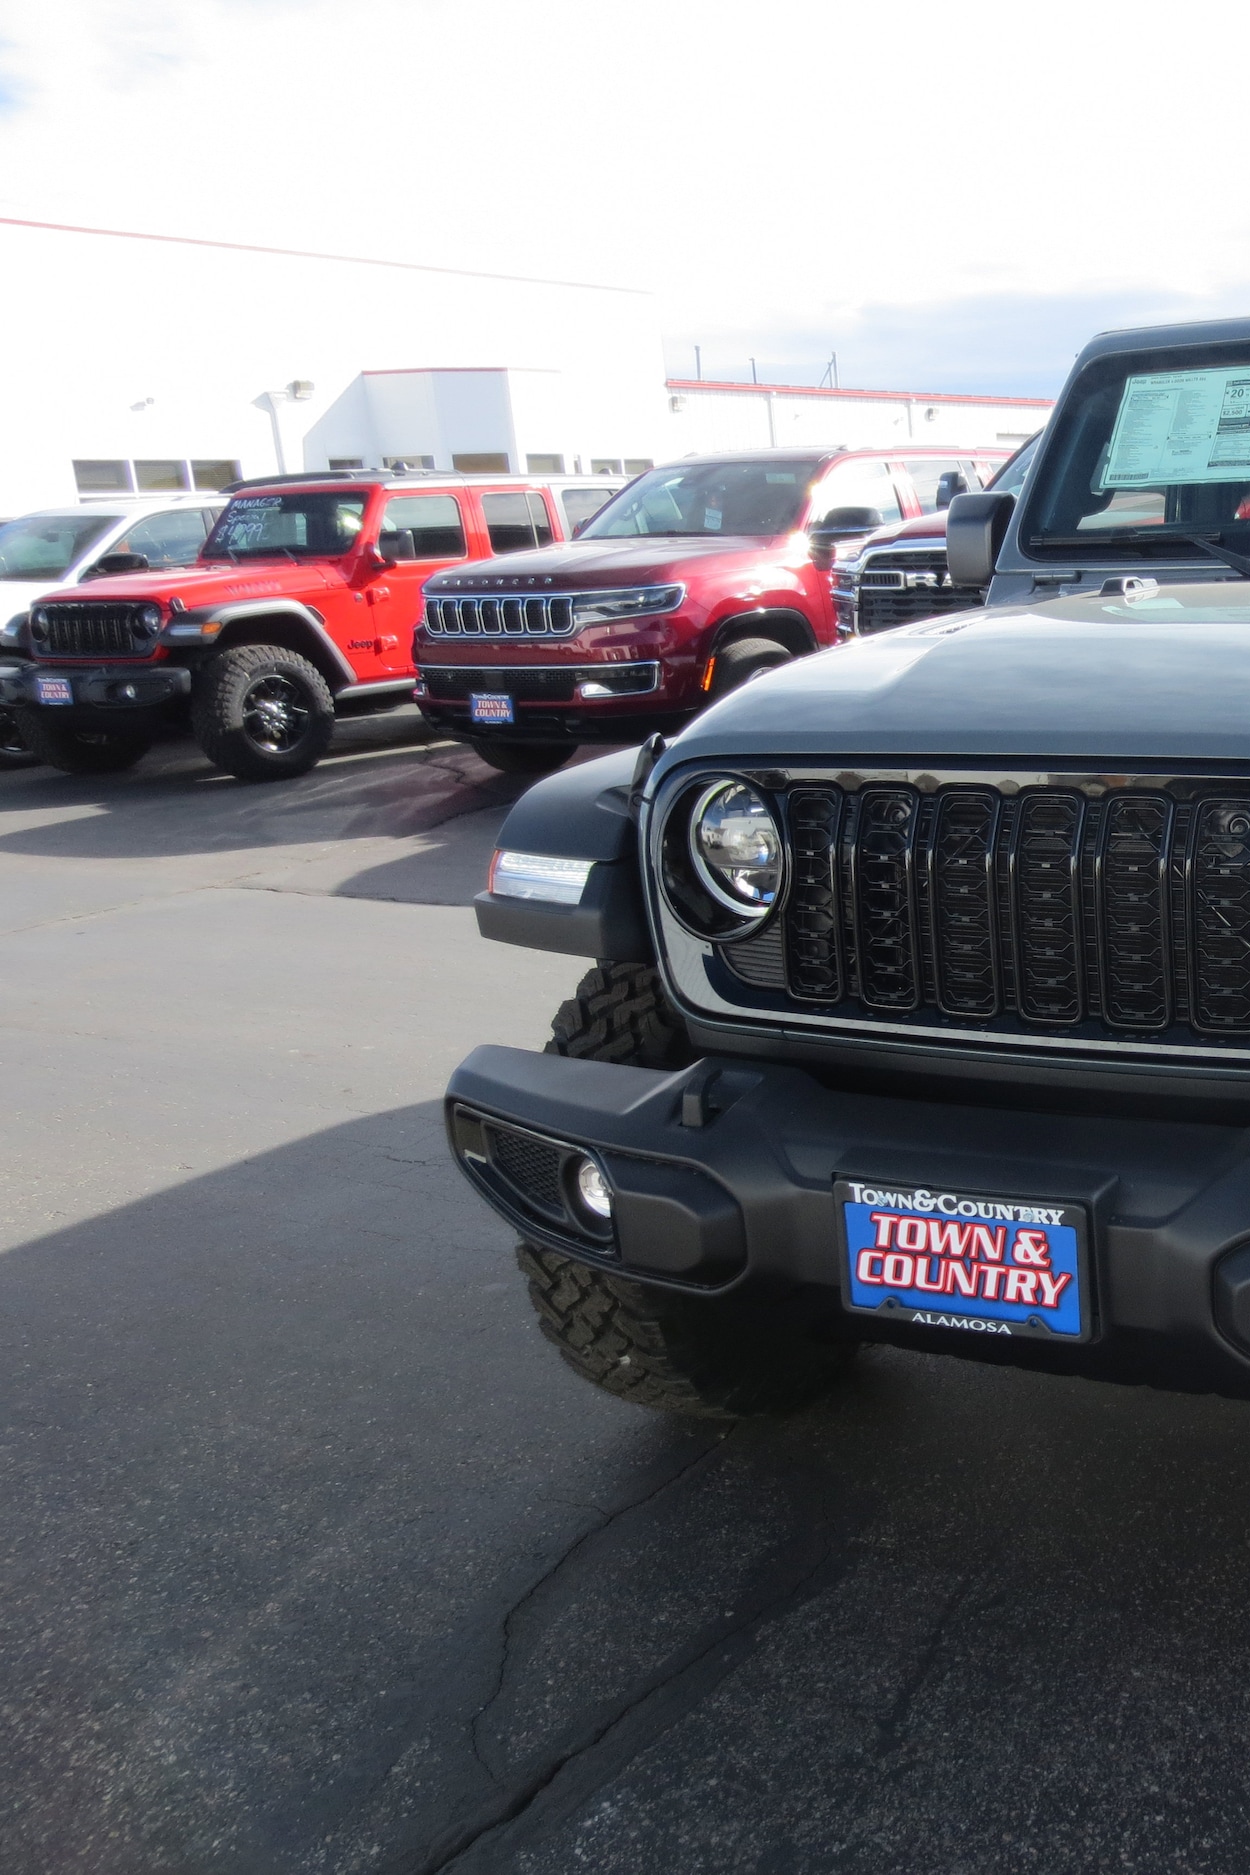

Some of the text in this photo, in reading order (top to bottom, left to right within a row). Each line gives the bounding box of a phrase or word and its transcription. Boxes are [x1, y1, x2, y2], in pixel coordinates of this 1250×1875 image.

[1231, 388, 1244, 398] 20
[347, 639, 373, 650] Jeep
[477, 700, 500, 708] TOWN
[475, 708, 511, 717] COUNTRY
[870, 1211, 1051, 1268] TOWN &
[856, 1248, 1071, 1308] COUNTRY
[912, 1312, 1012, 1335] ALAMOSA
